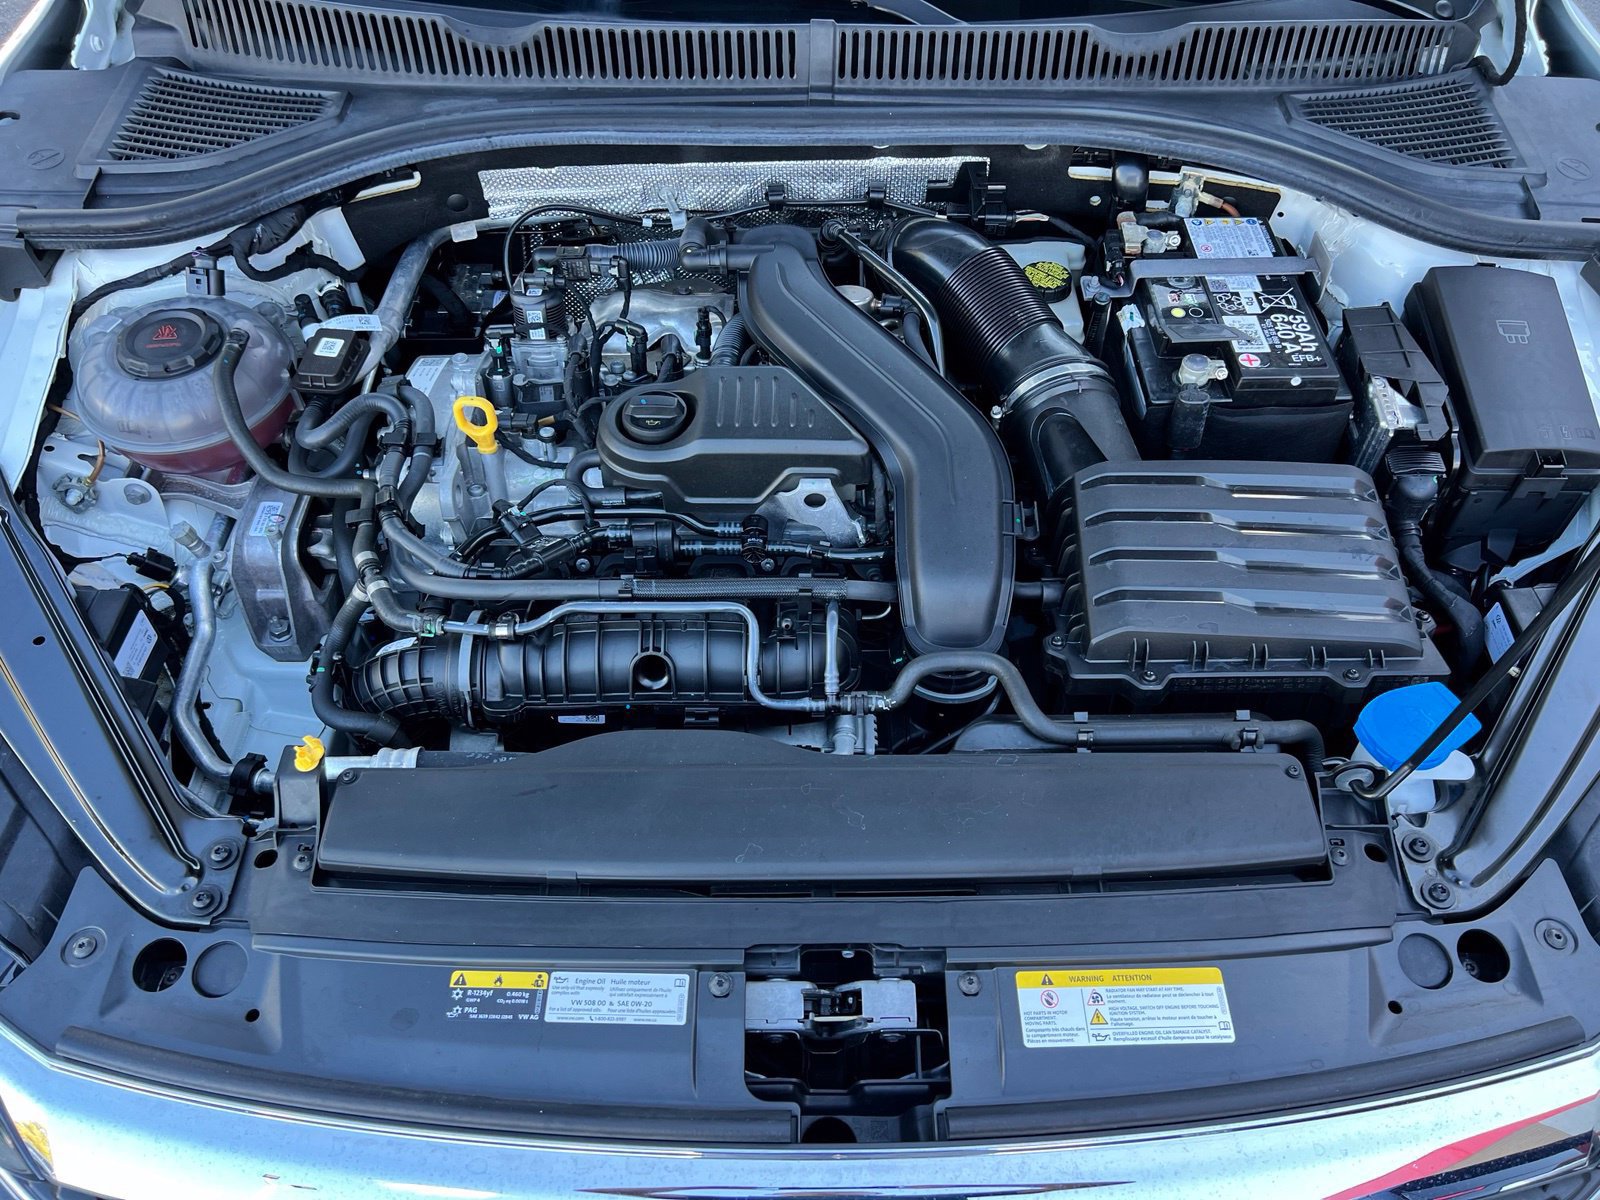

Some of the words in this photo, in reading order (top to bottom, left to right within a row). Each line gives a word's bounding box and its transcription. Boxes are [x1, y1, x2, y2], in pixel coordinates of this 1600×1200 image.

[1270, 314, 1296, 339] 640
[1288, 314, 1319, 352] 59Ah
[1282, 342, 1302, 354] A
[467, 990, 493, 998] R-1234yf
